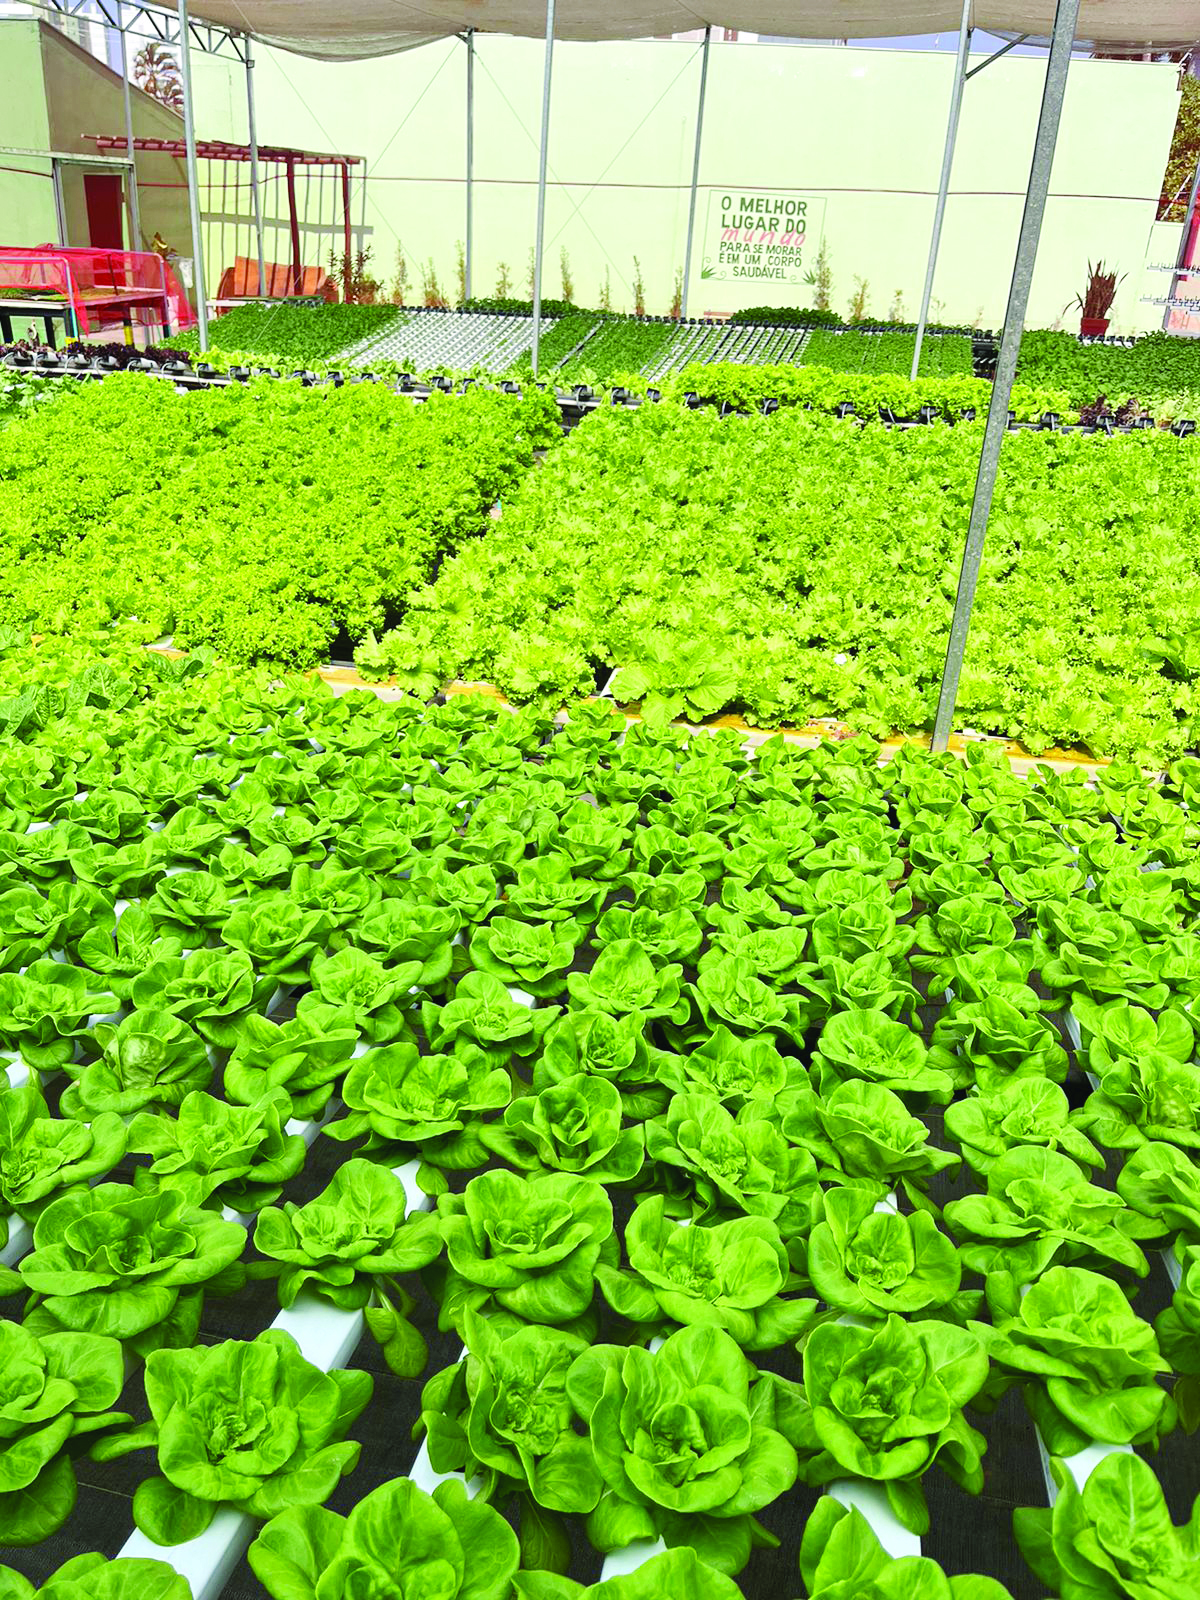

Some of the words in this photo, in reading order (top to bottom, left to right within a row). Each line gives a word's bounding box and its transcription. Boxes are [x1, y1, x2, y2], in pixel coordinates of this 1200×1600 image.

[721, 196, 731, 210] O
[740, 197, 807, 216] MELHOR
[721, 214, 780, 232] LUGAR
[786, 218, 806, 234] DO
[721, 228, 806, 246] mundo
[720, 242, 750, 253] PARA
[753, 244, 763, 254] SE
[766, 245, 801, 256] MORAR
[719, 251, 724, 263] É
[727, 253, 739, 264] EM
[745, 255, 760, 264] UM
[768, 256, 801, 267] CORPO
[733, 264, 786, 279] SAUDÁVEL
